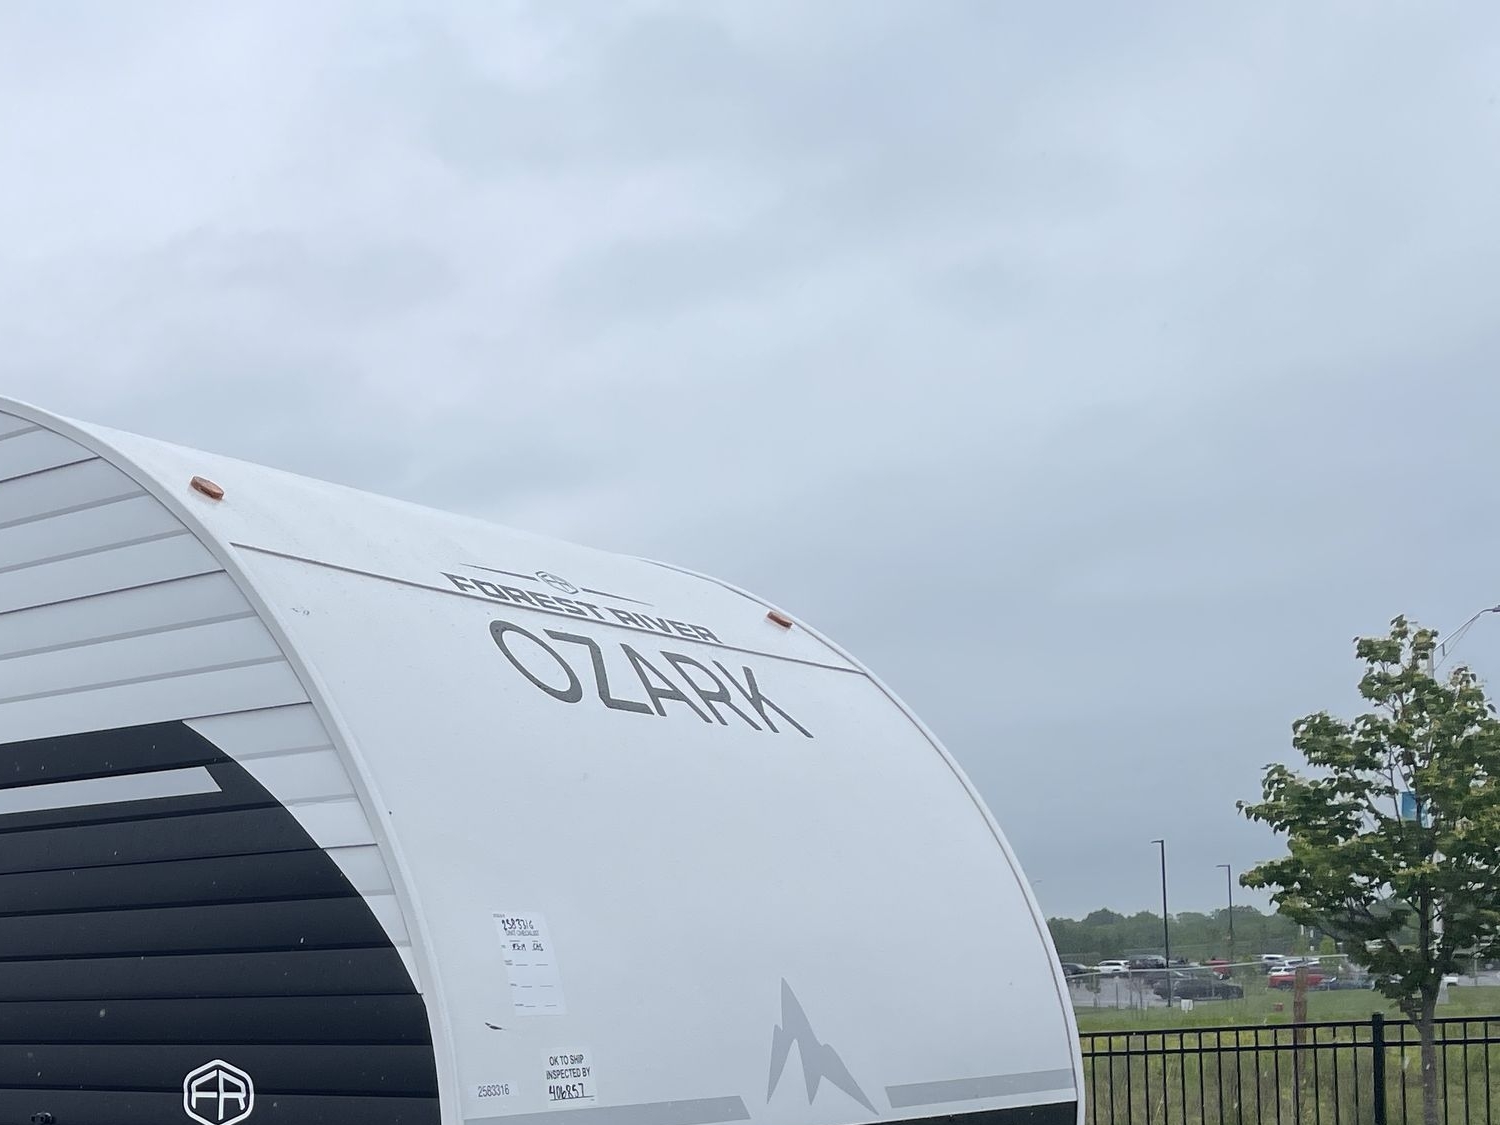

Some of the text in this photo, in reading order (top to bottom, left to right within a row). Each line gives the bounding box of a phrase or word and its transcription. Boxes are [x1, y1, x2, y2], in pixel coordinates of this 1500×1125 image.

[441, 571, 723, 644] FOREST RIVER
[488, 619, 814, 739] OZARK
[549, 1054, 584, 1066] OK TO SHIP
[546, 1067, 591, 1080] INSPECTED BY
[478, 1084, 510, 1098] 2583316
